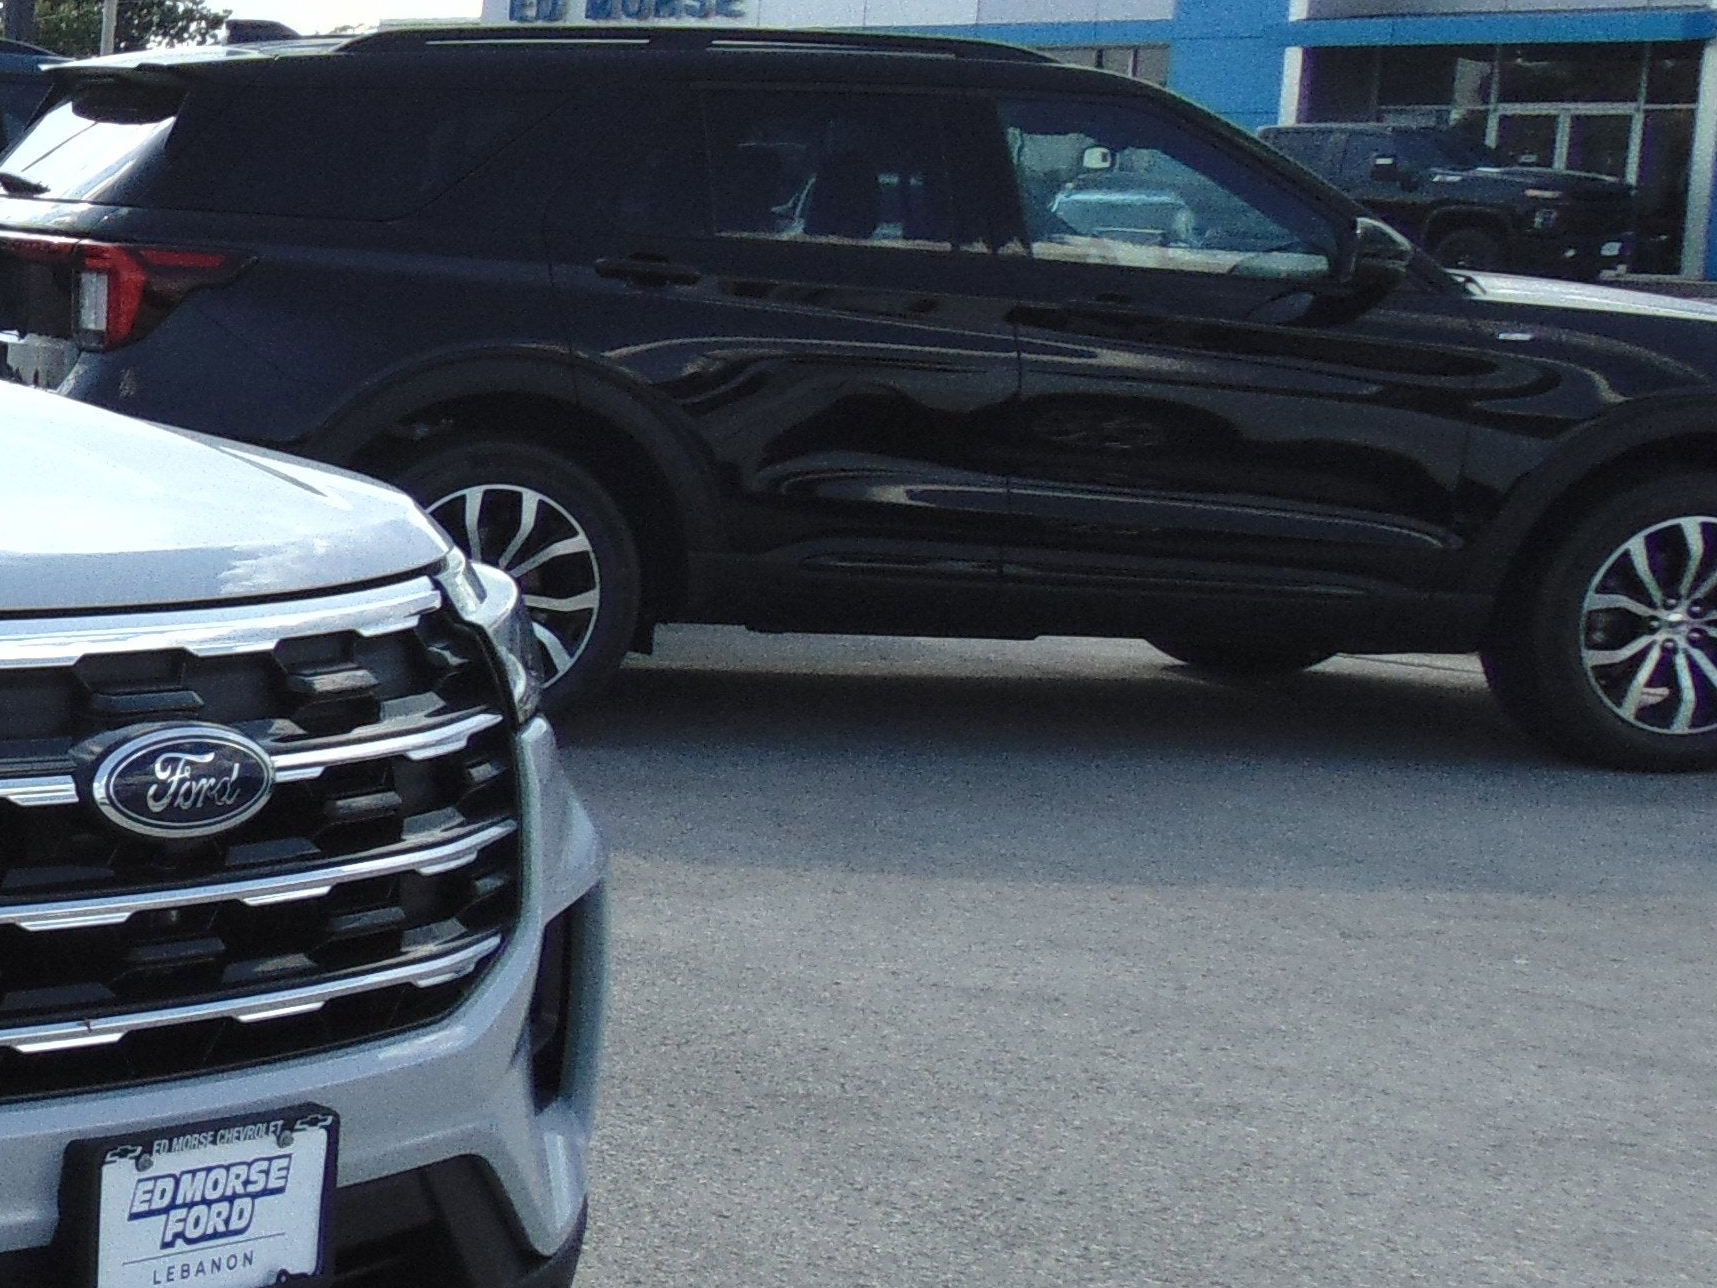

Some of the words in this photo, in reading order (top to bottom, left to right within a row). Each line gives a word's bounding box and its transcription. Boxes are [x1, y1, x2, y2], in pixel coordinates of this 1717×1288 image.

[147, 752, 240, 812] Ford
[152, 1139, 170, 1156] ED
[172, 1131, 215, 1153] MORSE
[216, 1119, 284, 1146] CHEVROLET
[127, 1174, 177, 1221] ED
[174, 1153, 293, 1208] MORSE
[161, 1197, 255, 1250] FORD
[153, 1250, 253, 1285] LEBANON
